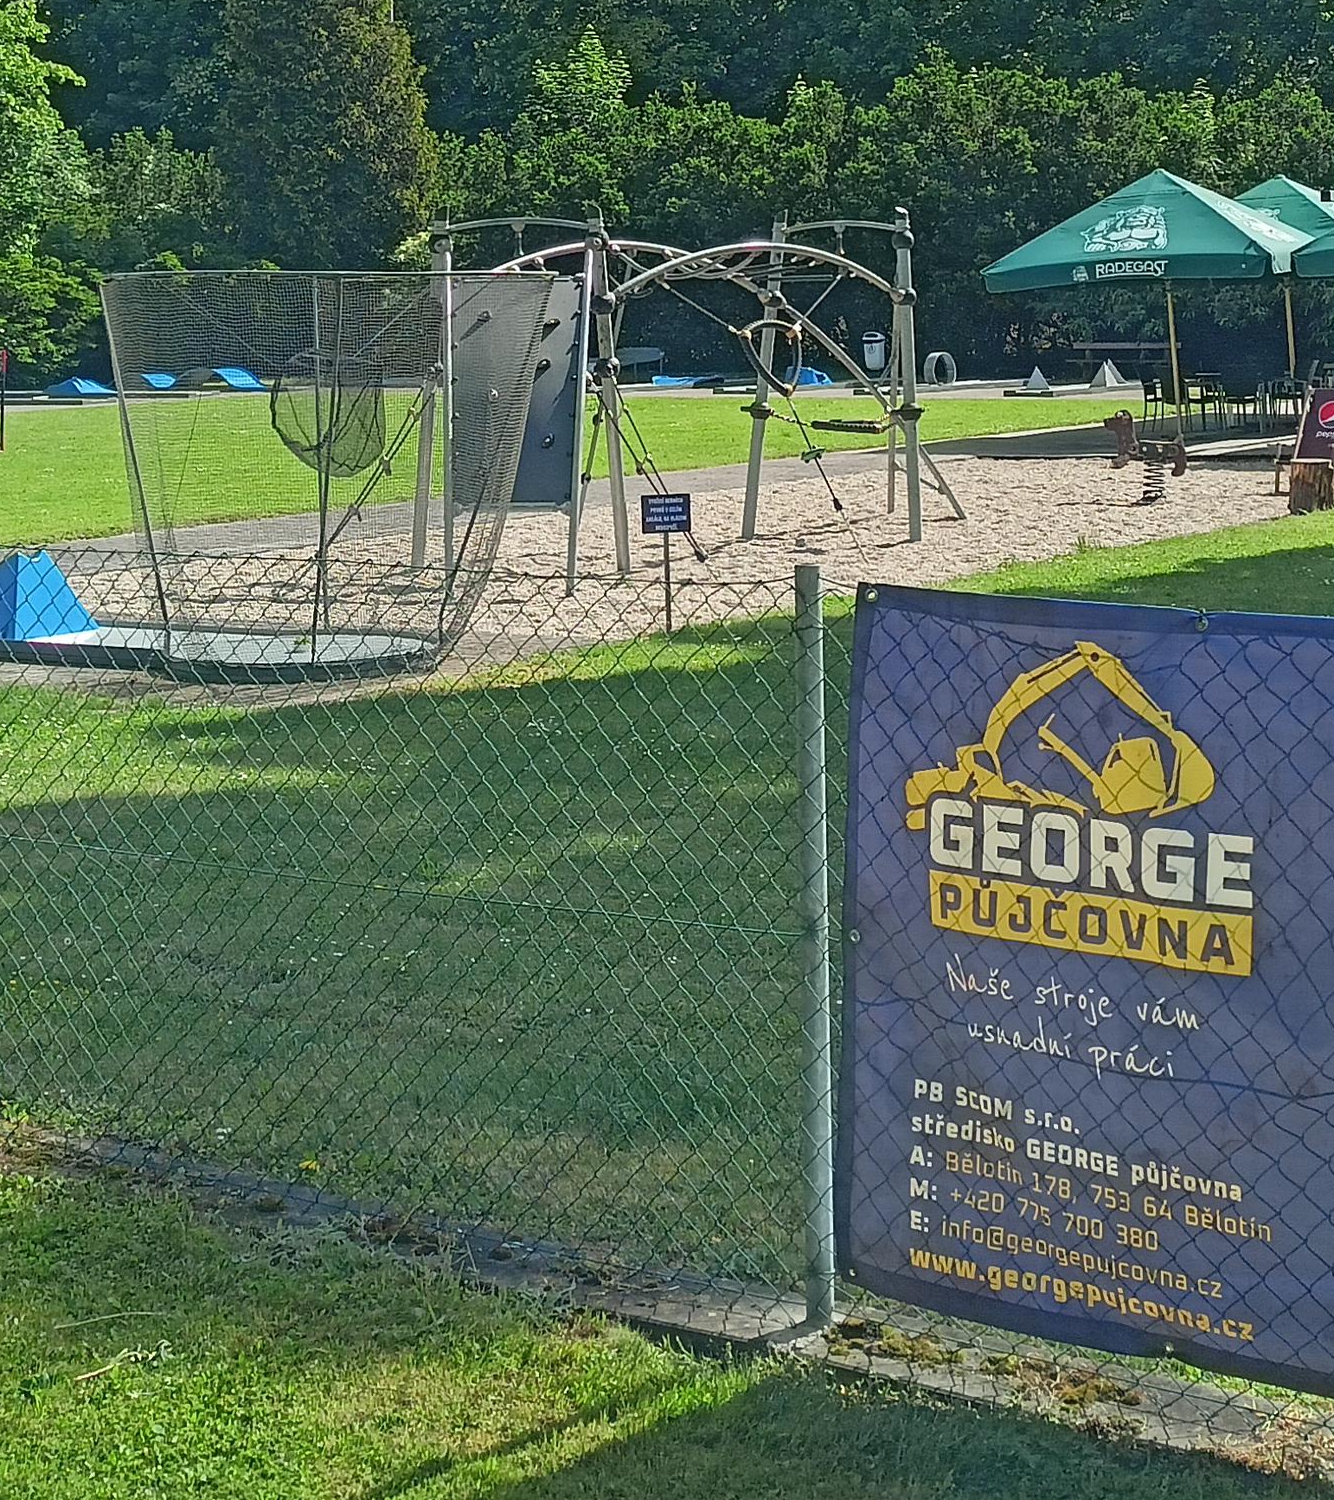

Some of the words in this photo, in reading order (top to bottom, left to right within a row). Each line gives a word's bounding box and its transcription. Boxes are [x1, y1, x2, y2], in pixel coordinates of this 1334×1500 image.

[1095, 261, 1169, 278] RADEGAST
[929, 798, 1254, 909] GEORGE
[939, 880, 1235, 966] PŮJČOVNA
[945, 953, 1013, 1000] Naše
[1034, 976, 1113, 1026] stroje
[1136, 997, 1200, 1030] vám
[968, 1016, 1072, 1059] usnadní
[1088, 1045, 1174, 1080] práci
[914, 1078, 943, 1102] PB
[955, 1086, 1013, 1121] SCOM
[1024, 1108, 1080, 1135] s.r.o.
[910, 1145, 933, 1168] A:
[946, 1151, 1023, 1186] Bělotín
[1032, 1172, 1077, 1204] 178,
[1091, 1184, 1131, 1213] 753
[1143, 1196, 1172, 1220] 64
[1185, 1204, 1271, 1242] Bělotín
[911, 1113, 1015, 1153] středisko
[1026, 1138, 1118, 1177] GEORGE
[1131, 1161, 1242, 1202] půjčovna
[910, 1177, 937, 1201] M:
[950, 1188, 1005, 1213] +420
[1017, 1197, 1051, 1227] 775
[1062, 1212, 1103, 1240] 700
[1116, 1224, 1159, 1251] 380
[910, 1210, 930, 1233] E:
[942, 1214, 1223, 1298] info@georgepujcovna.cz
[910, 1248, 1255, 1342] www.georgepujcovna.cz
